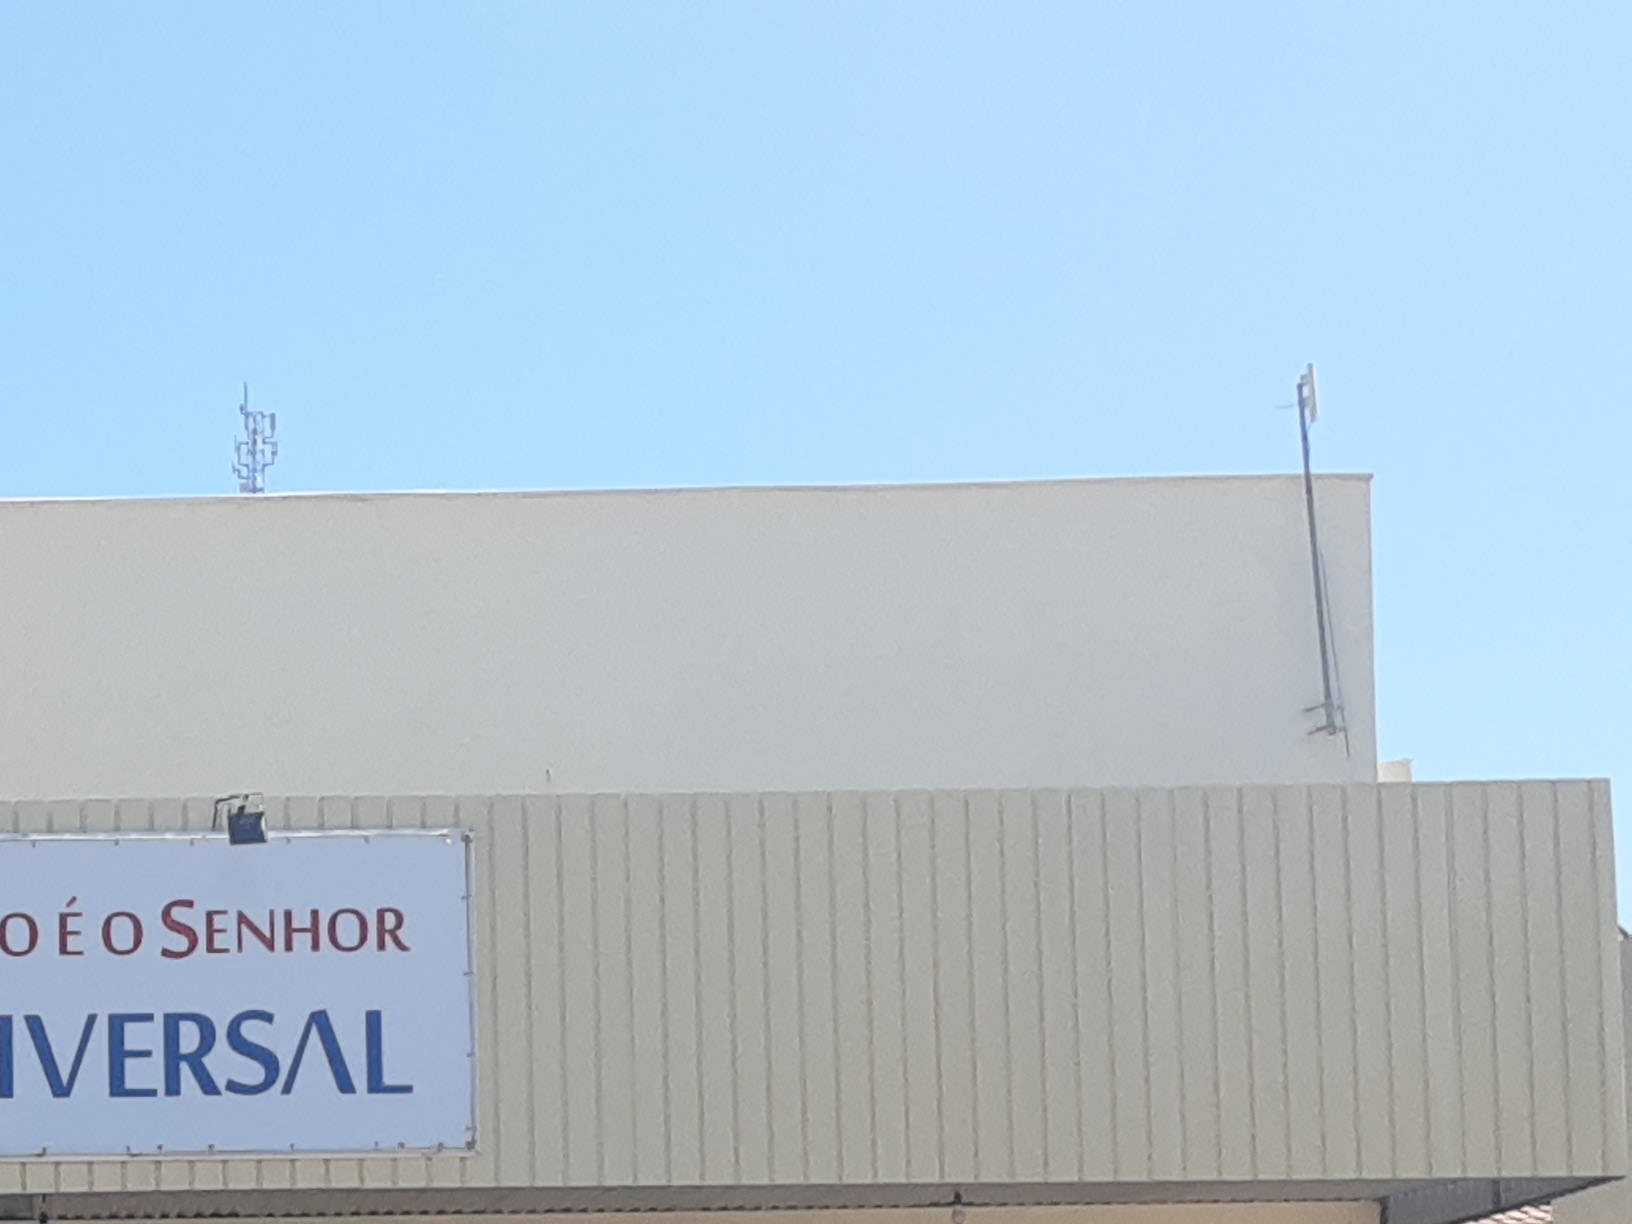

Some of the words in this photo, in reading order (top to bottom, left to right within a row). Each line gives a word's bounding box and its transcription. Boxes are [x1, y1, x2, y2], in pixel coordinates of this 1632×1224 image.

[58, 897, 85, 957] É
[101, 911, 144, 956] O
[160, 899, 411, 960] SENHOR
